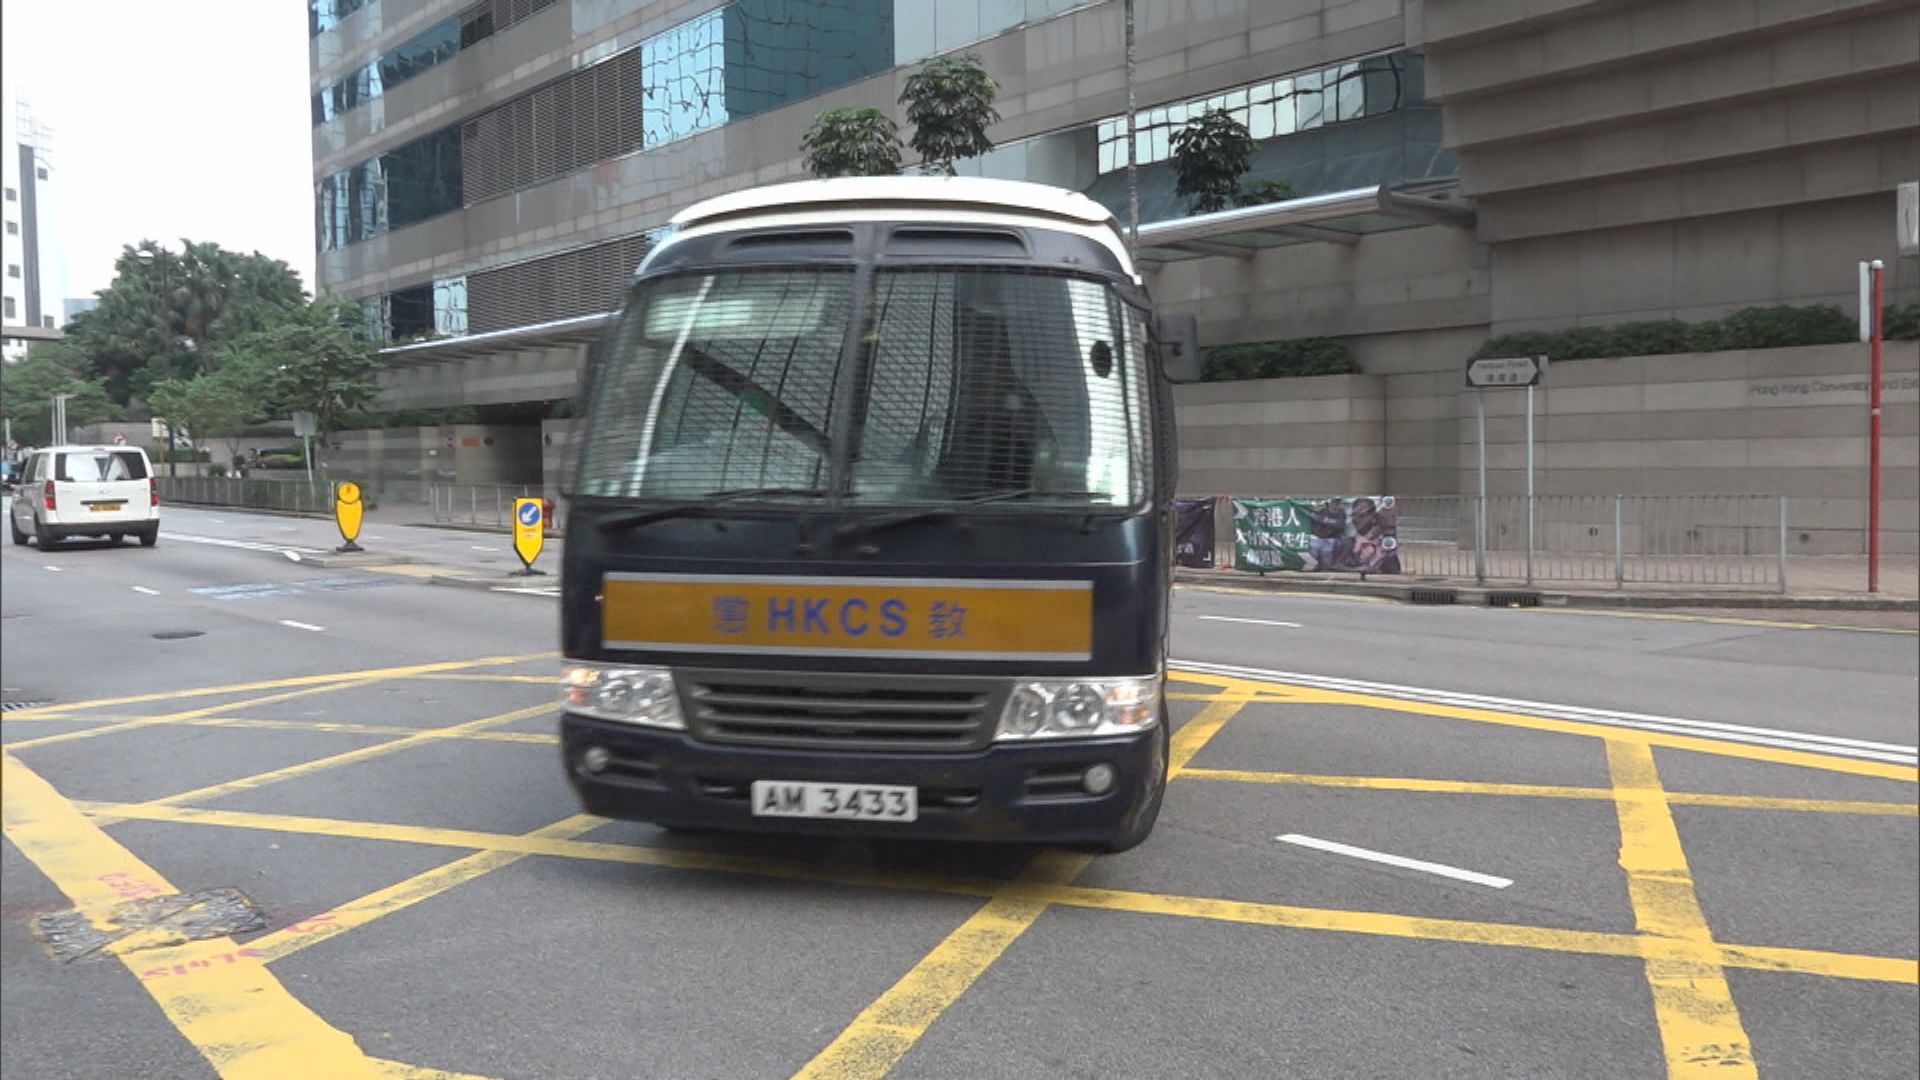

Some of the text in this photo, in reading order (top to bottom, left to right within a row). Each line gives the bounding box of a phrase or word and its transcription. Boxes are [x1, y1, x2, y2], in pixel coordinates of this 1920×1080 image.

[767, 597, 907, 638] HKCS
[927, 599, 967, 639] 教
[761, 785, 908, 816] AM 3433
